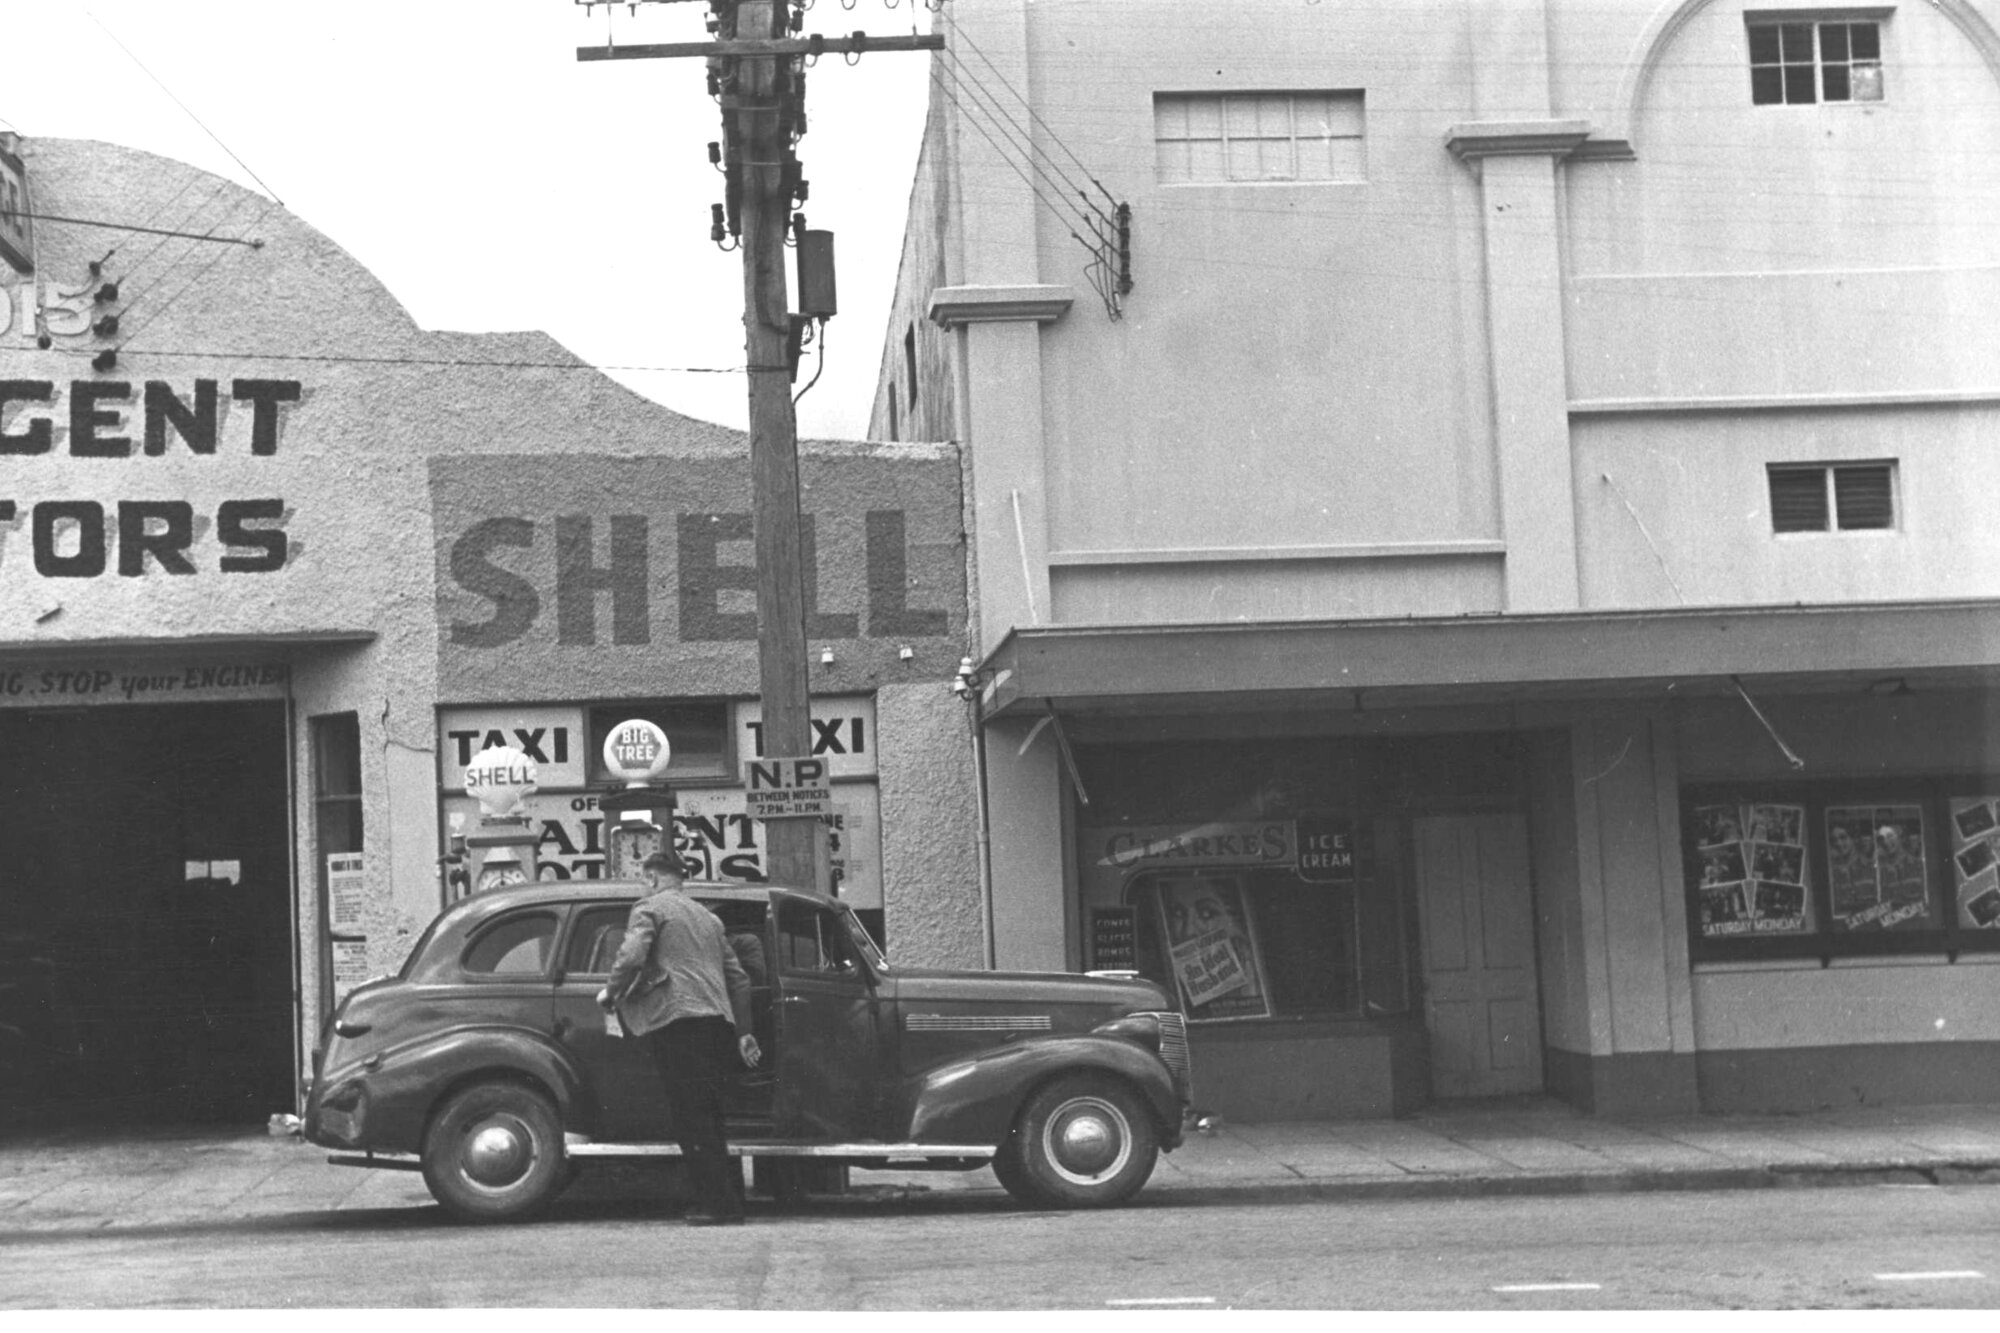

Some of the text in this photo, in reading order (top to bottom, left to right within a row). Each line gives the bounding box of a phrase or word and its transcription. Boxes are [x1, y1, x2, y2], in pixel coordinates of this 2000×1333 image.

[0, 499, 288, 577] ORS
[449, 510, 949, 648] SHELL
[39, 669, 112, 694] STOP
[119, 675, 179, 699] your
[621, 728, 649, 744] BIG
[746, 717, 864, 757] TXI
[616, 745, 654, 761] TREE
[467, 766, 534, 787] SHELL
[751, 760, 823, 789] N.P.
[747, 789, 829, 803] BETWEEN NOTICES
[1309, 833, 1345, 849] ICE
[1302, 852, 1351, 868] CREAM
[1702, 917, 1801, 936] SATURDAY MONDAY
